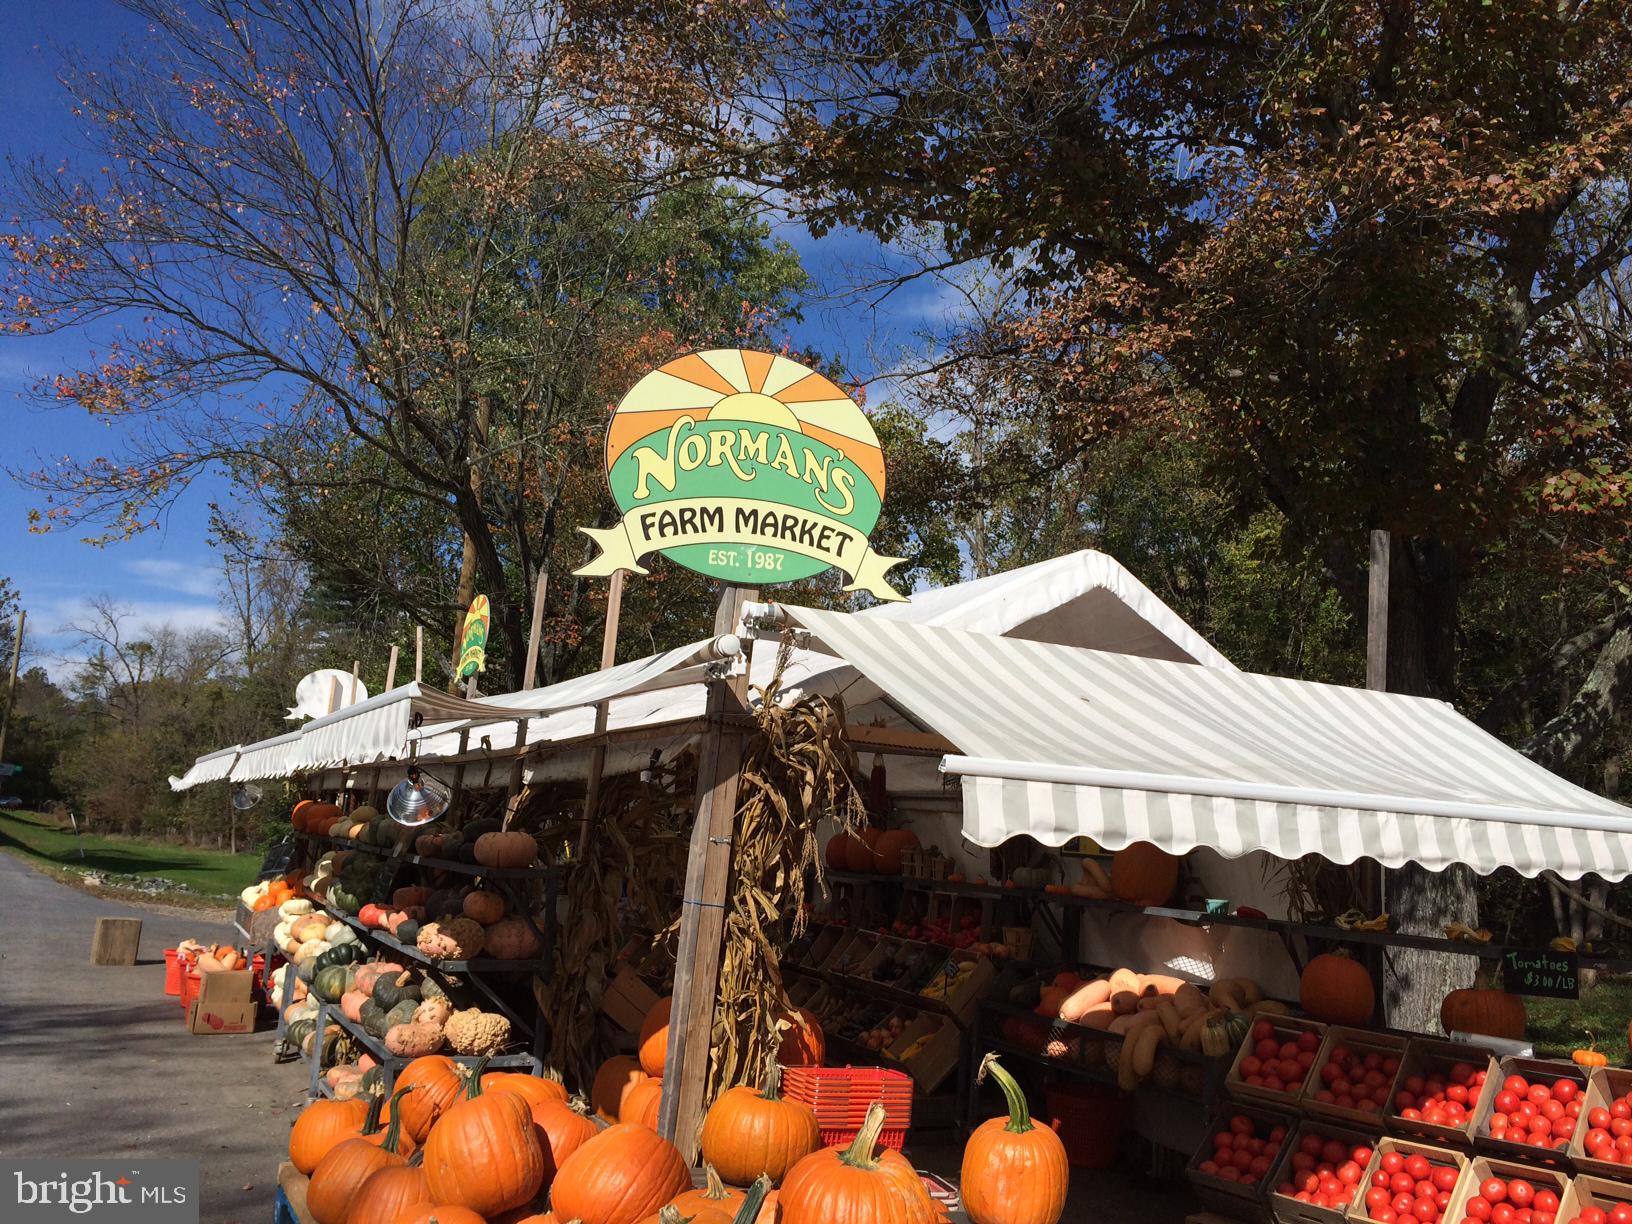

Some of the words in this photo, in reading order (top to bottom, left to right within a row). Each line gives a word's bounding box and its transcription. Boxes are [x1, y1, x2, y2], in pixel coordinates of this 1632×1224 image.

[631, 415, 855, 515] NORMAN'S
[640, 506, 724, 541] FARM
[735, 507, 853, 558] MARKET
[708, 550, 740, 568] EST.
[747, 550, 785, 571] 1987
[1506, 952, 1569, 972] Tomatoes
